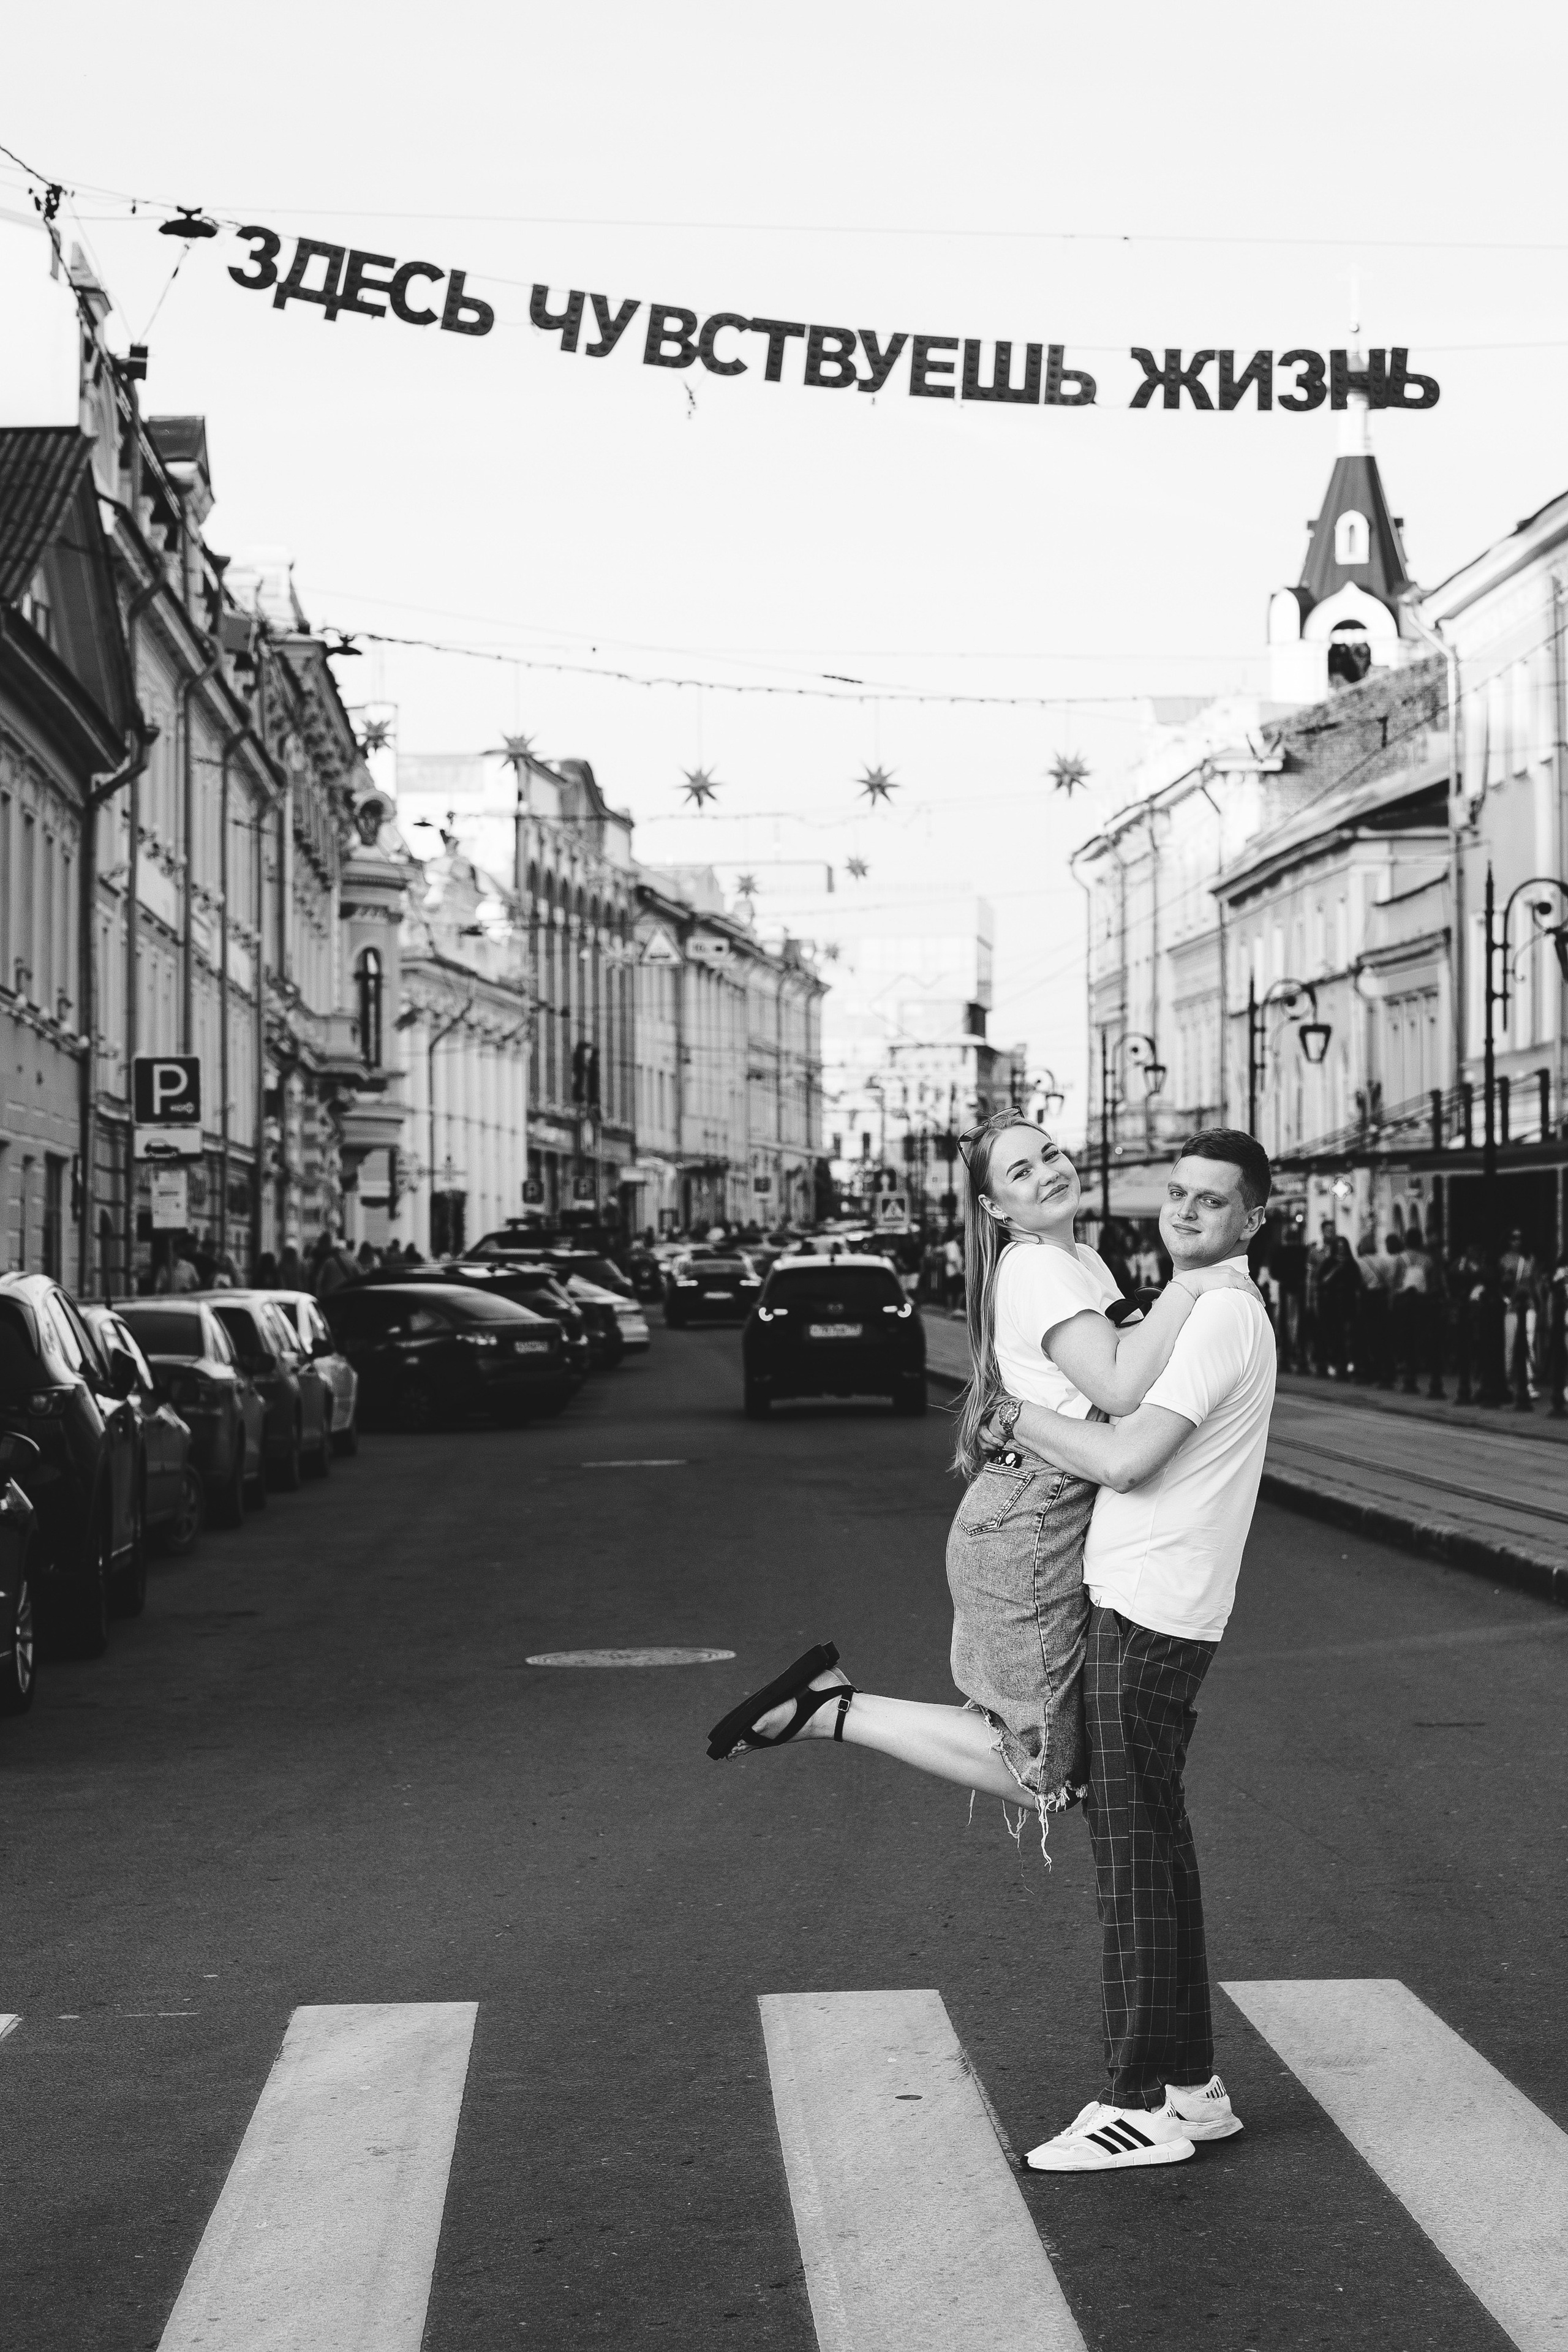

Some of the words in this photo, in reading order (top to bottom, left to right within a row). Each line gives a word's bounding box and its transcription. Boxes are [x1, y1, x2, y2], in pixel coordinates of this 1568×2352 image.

[227, 225, 495, 336] ЗДЕСЬ
[529, 284, 1097, 406] ЧУВСТВУЕШЬ
[1129, 347, 1441, 412] ЖИЗНЬ
[153, 1063, 188, 1115] P
